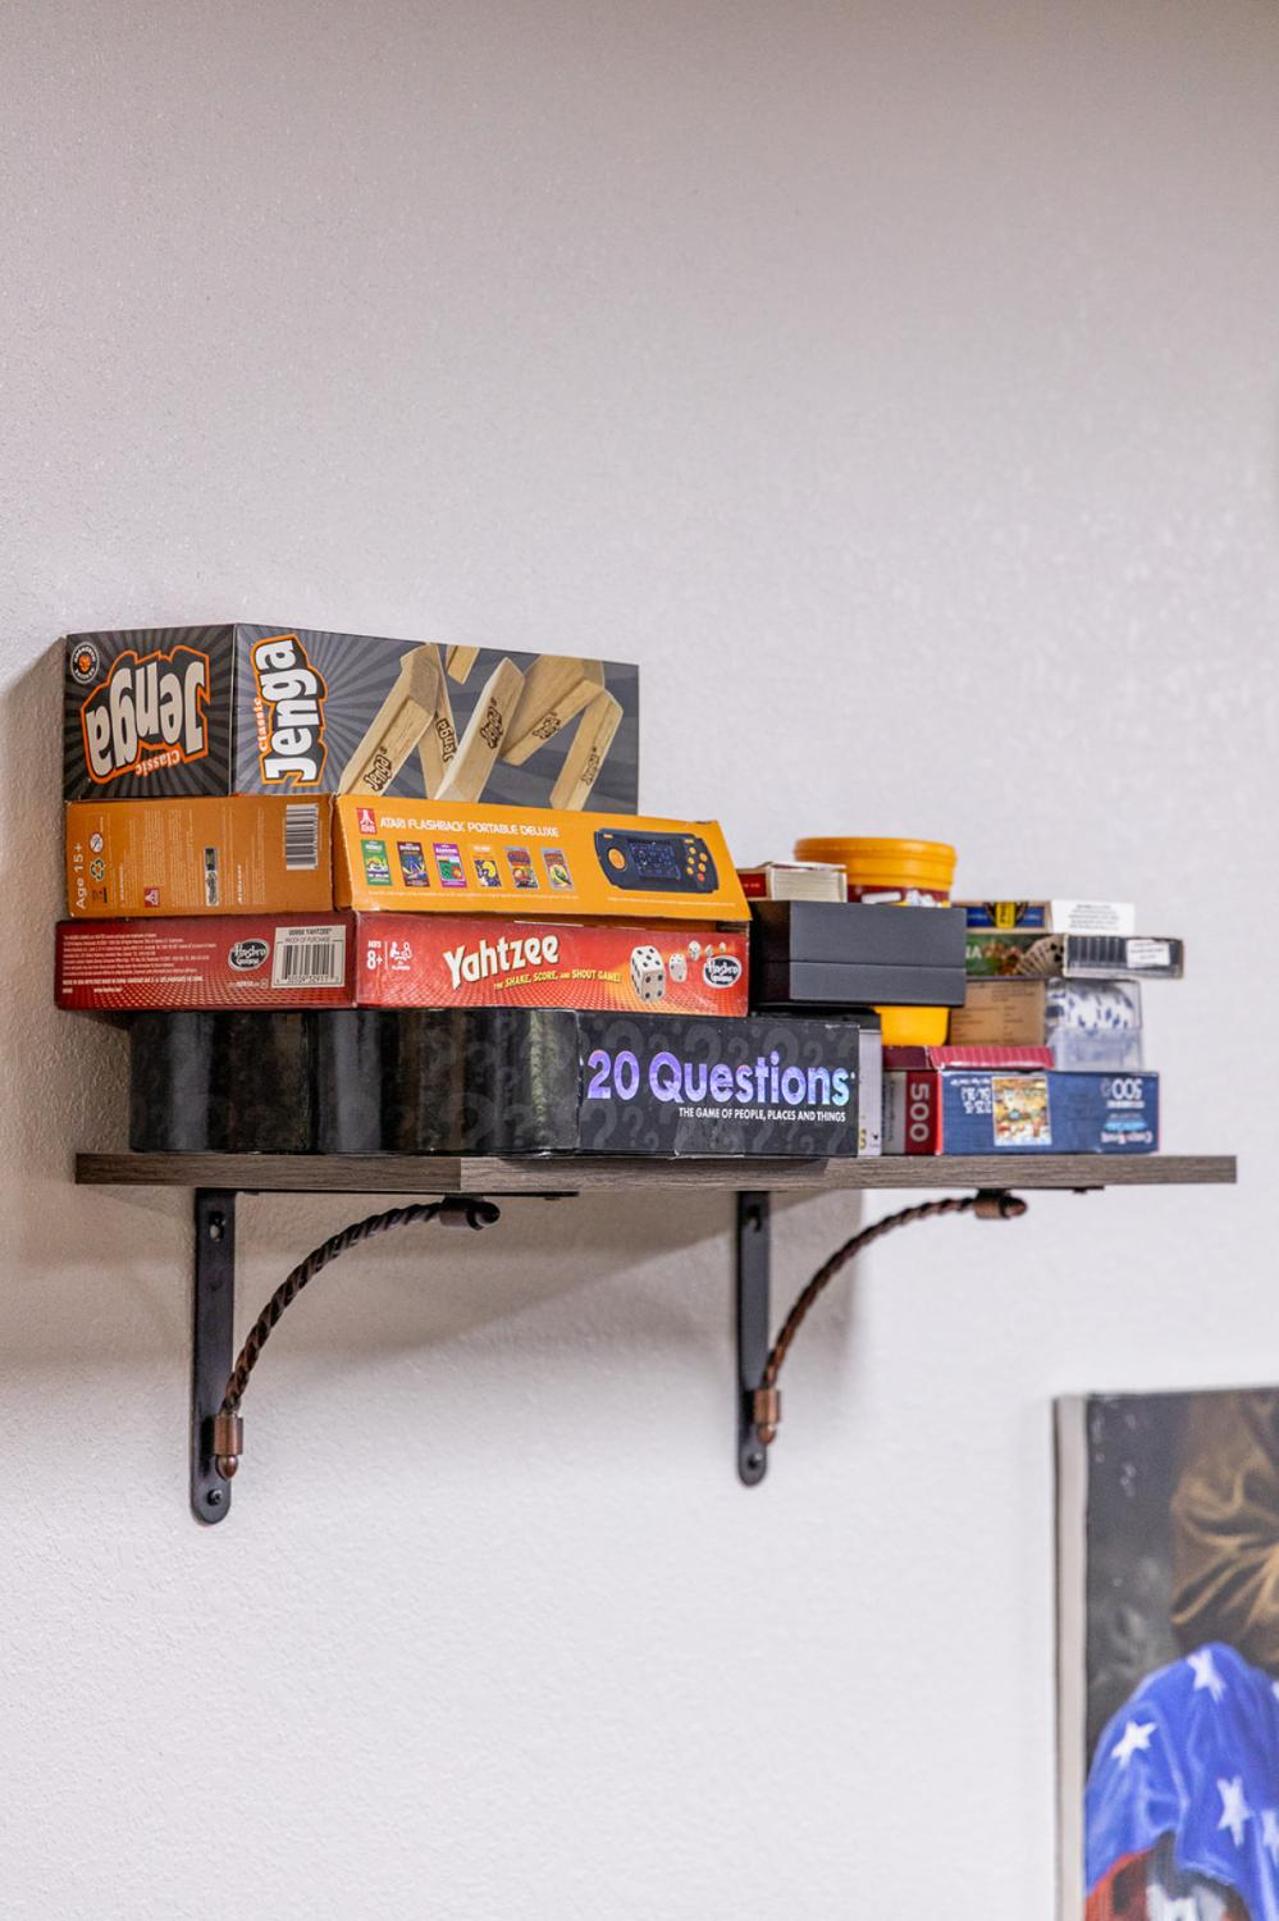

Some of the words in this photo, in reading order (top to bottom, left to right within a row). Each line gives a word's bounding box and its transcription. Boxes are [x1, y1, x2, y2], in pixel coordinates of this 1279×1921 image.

[85, 661, 205, 777] Jenga
[254, 698, 268, 751] Classic
[255, 639, 320, 781] Jenga
[135, 749, 180, 776] Classic
[363, 754, 393, 791] Jenga
[380, 817, 406, 829] ATARI
[407, 818, 465, 833] FLASHBACK
[467, 821, 518, 835] PORTABLE
[520, 825, 560, 839] DELUXE
[74, 843, 84, 872] 15+
[76, 877, 87, 910] Age
[367, 950, 383, 970] 8+
[443, 934, 560, 989] Yahtzee
[572, 969, 597, 980] SHOUT
[586, 1050, 640, 1101] 20
[650, 1051, 850, 1106] Questions
[679, 1107, 695, 1118] THE
[696, 1107, 720, 1118] GAME
[721, 1108, 732, 1119] OF
[734, 1109, 767, 1121] PEOPLE,
[767, 1109, 797, 1121] PLACES
[798, 1110, 816, 1121] AND
[816, 1111, 846, 1122] THINGS
[909, 1083, 930, 1142] 500
